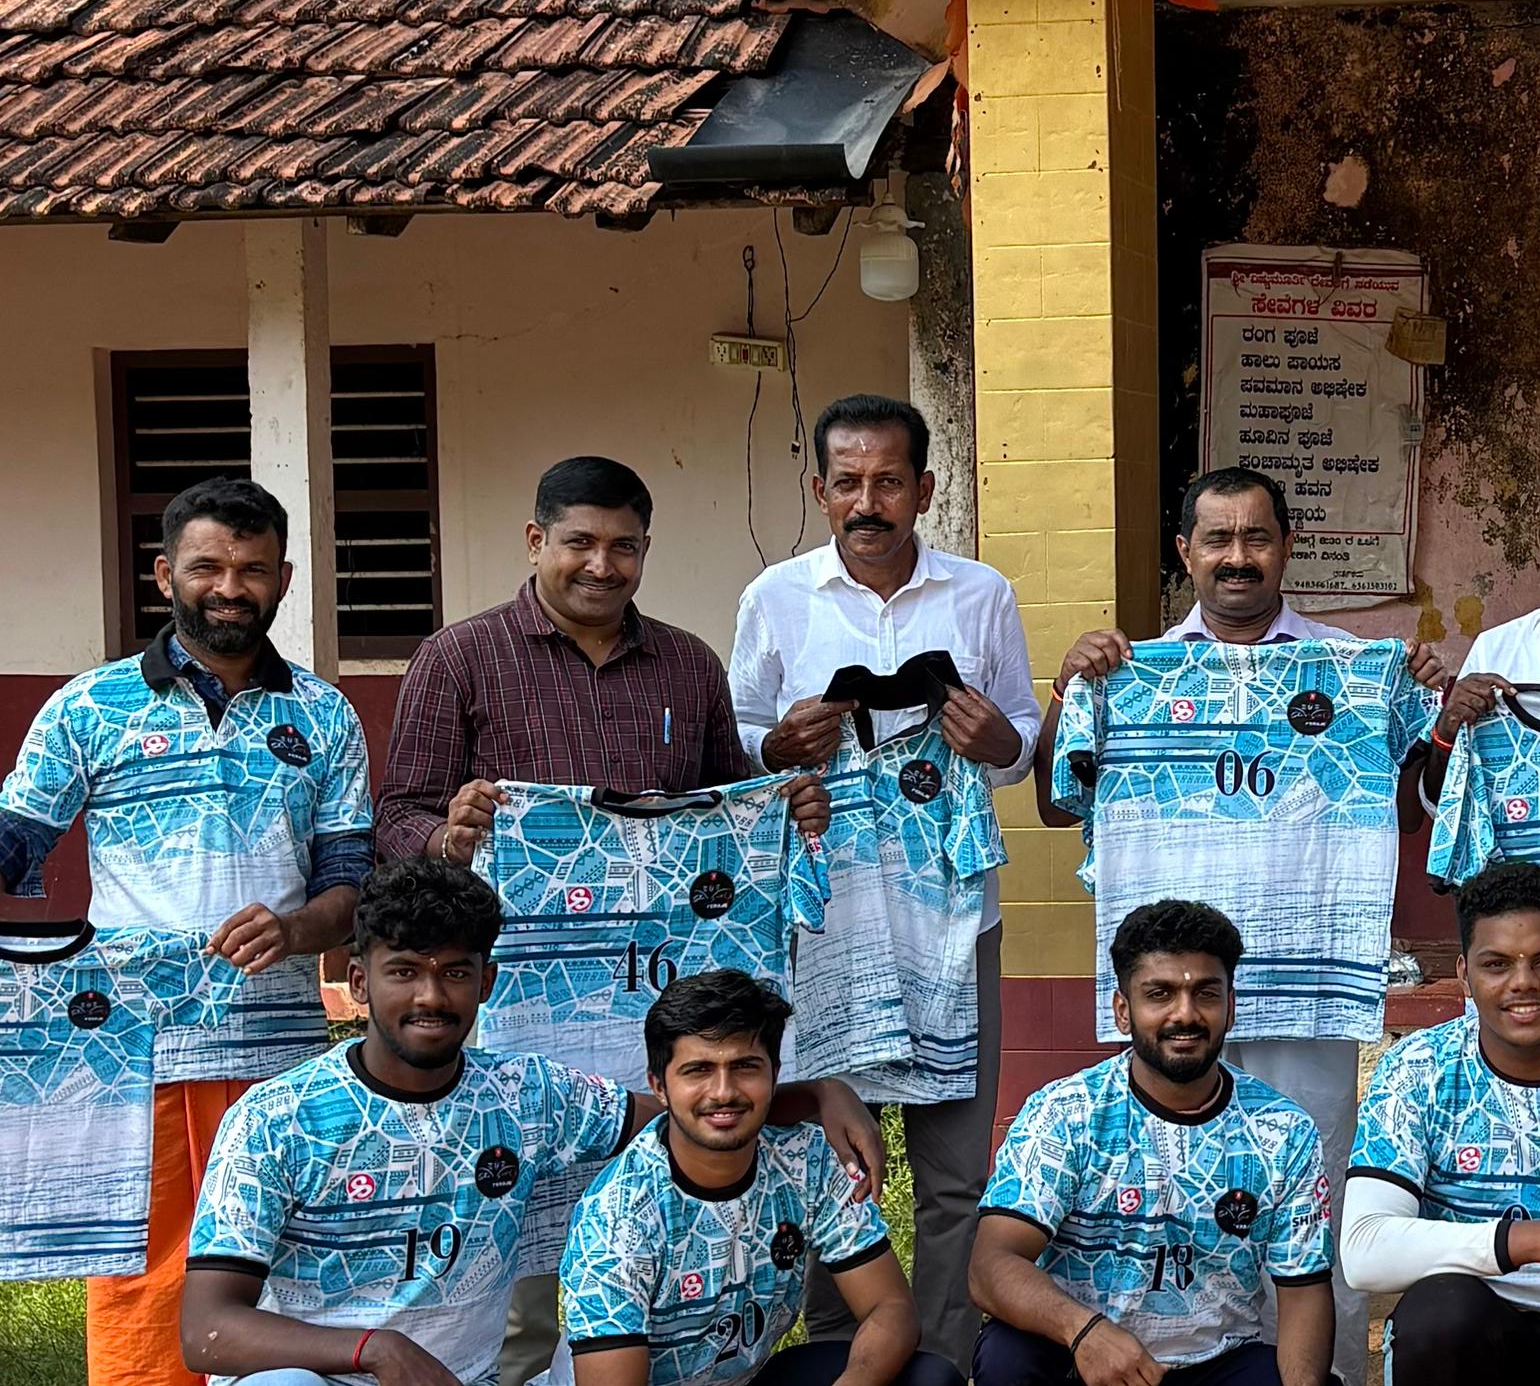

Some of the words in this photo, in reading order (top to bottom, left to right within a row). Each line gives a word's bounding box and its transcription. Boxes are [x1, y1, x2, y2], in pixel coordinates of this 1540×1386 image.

[1331, 299, 1378, 318] ವಿವರ
[1241, 325, 1276, 343] ರಂಗ
[1284, 327, 1319, 348] ಪೂಜೆ
[1240, 353, 1281, 369] ಹಾಲು
[1287, 354, 1341, 371] ಪಾಯಸ
[1240, 377, 1304, 395] ಪವಮಾನ
[1239, 428, 1290, 445] ಹೂವಿನ
[1297, 428, 1333, 449] ಪೂಜೆ
[1294, 479, 1332, 497] ಹವನ
[1215, 750, 1275, 797] 06
[612, 939, 678, 993] 46
[397, 1223, 462, 1283] 19
[1146, 1244, 1195, 1293] 18
[714, 1299, 766, 1364] 20
